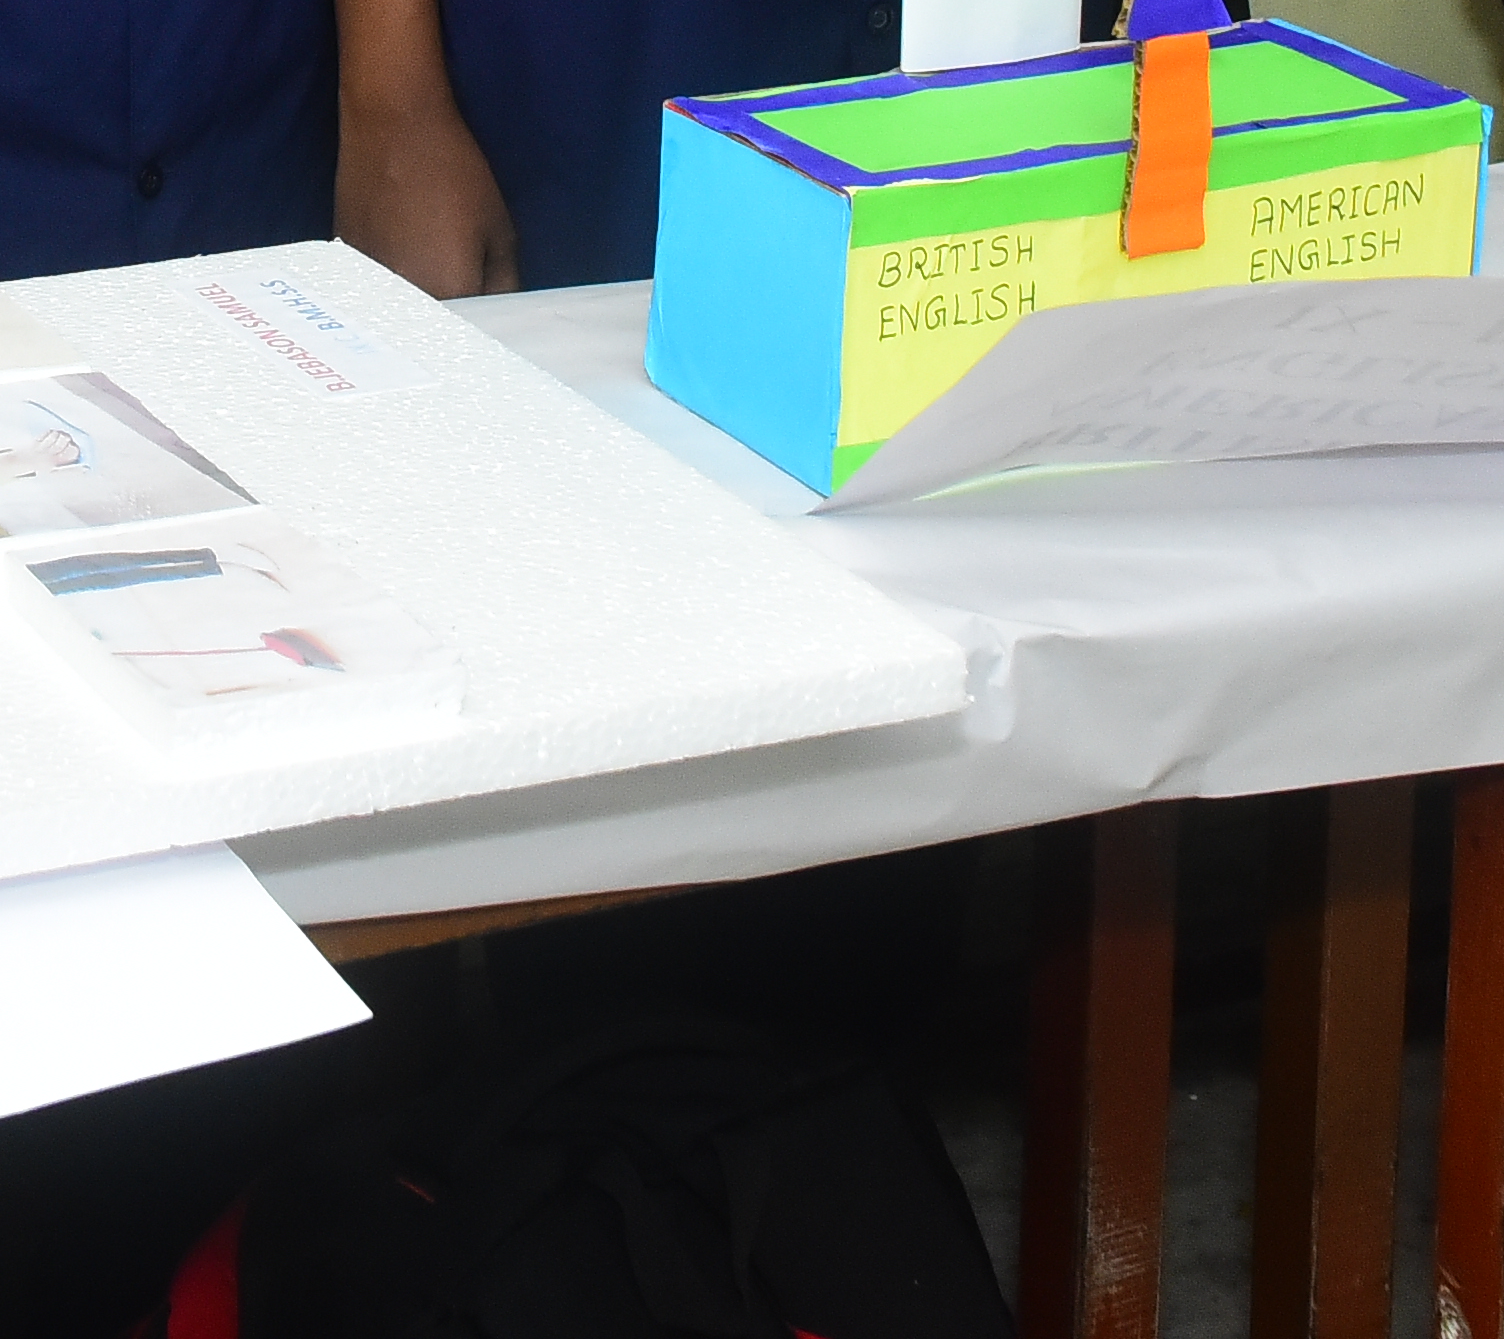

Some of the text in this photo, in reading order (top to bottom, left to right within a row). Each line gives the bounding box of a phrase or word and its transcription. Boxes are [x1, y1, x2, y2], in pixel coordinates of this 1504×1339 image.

[1250, 173, 1426, 237] AMERICAN
[879, 235, 1036, 289] BRITISH
[1249, 228, 1403, 283] ENGLISH
[195, 282, 357, 392] B.JEBASON SAMUEL
[879, 280, 1038, 342] ENGLISH
